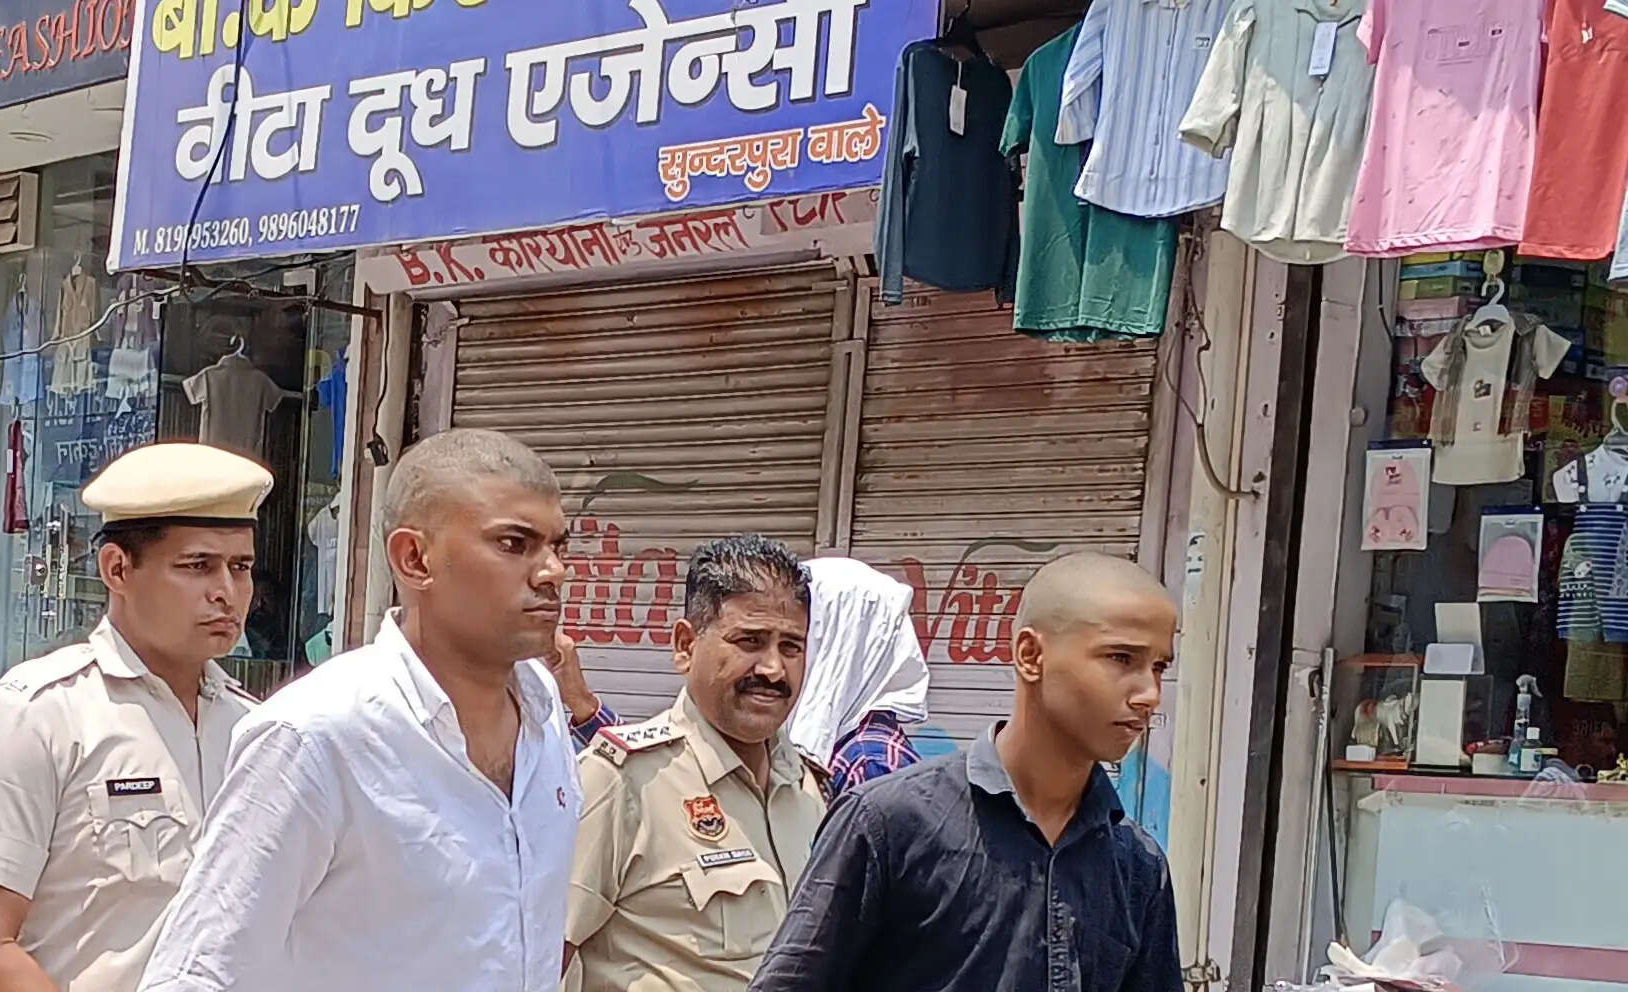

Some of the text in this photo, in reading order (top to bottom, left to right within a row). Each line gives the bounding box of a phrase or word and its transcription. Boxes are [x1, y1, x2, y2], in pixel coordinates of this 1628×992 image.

[175, 64, 331, 184] वीटा
[347, 58, 485, 202] दूध
[659, 103, 886, 201] सुन्दरपुरा वाले
[133, 229, 149, 255] M.
[258, 204, 360, 243] 9896048177
